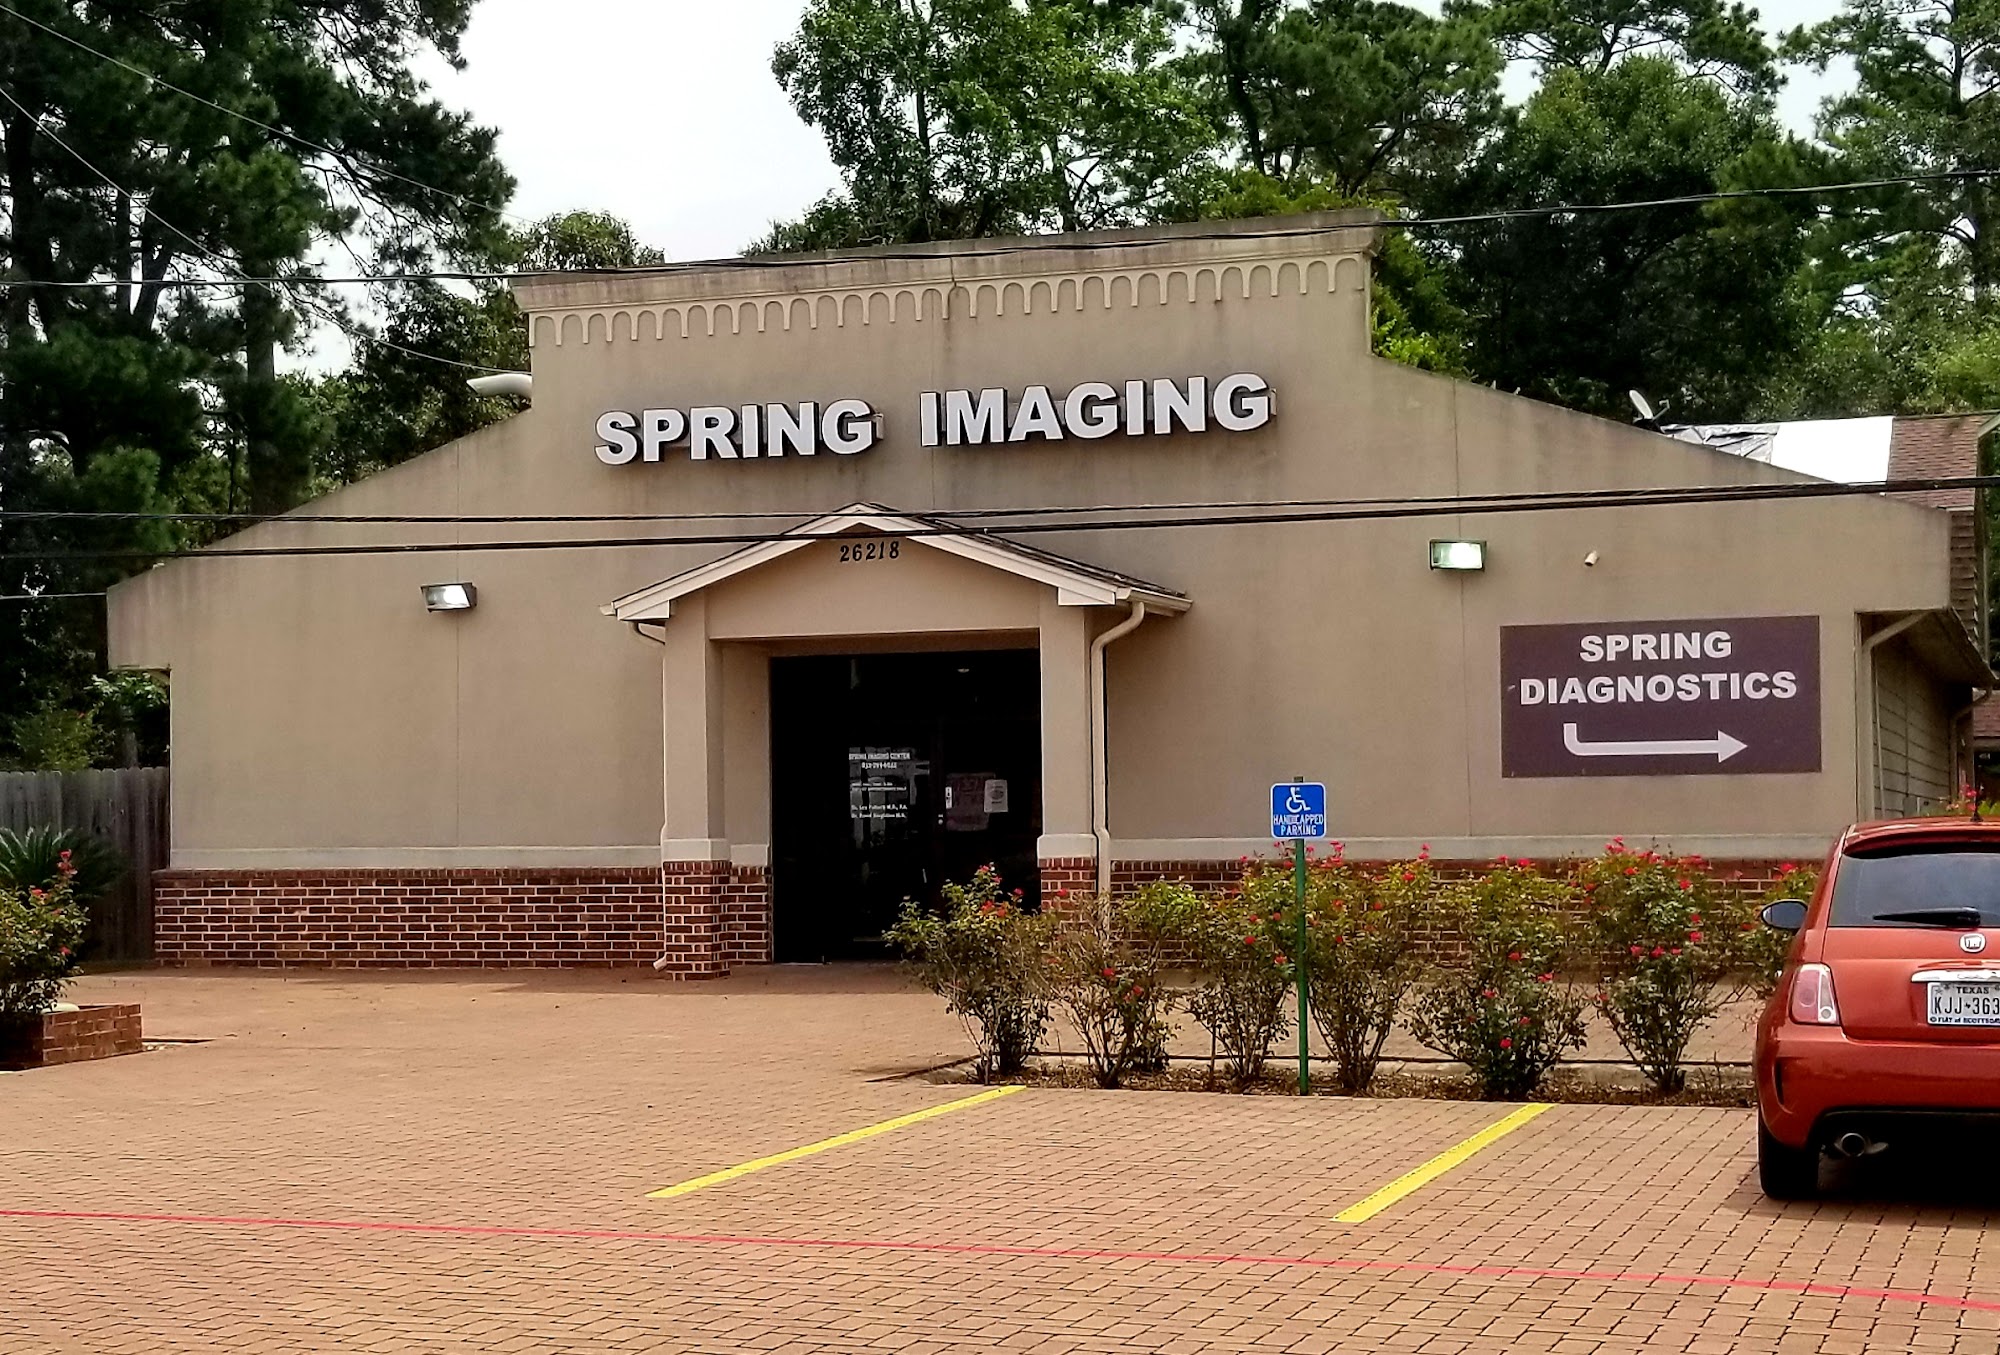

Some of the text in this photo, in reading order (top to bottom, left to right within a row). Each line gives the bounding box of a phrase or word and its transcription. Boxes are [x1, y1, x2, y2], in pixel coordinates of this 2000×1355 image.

[593, 372, 1270, 466] SPRING IMAGING
[840, 541, 899, 562] 26218
[1579, 631, 1732, 662] SPRING
[1520, 671, 1797, 705] DIAGNOSTICS
[1273, 814, 1324, 825] HANDICAPPED
[1280, 824, 1317, 836] PARKING
[1956, 986, 1989, 994] TEXAS
